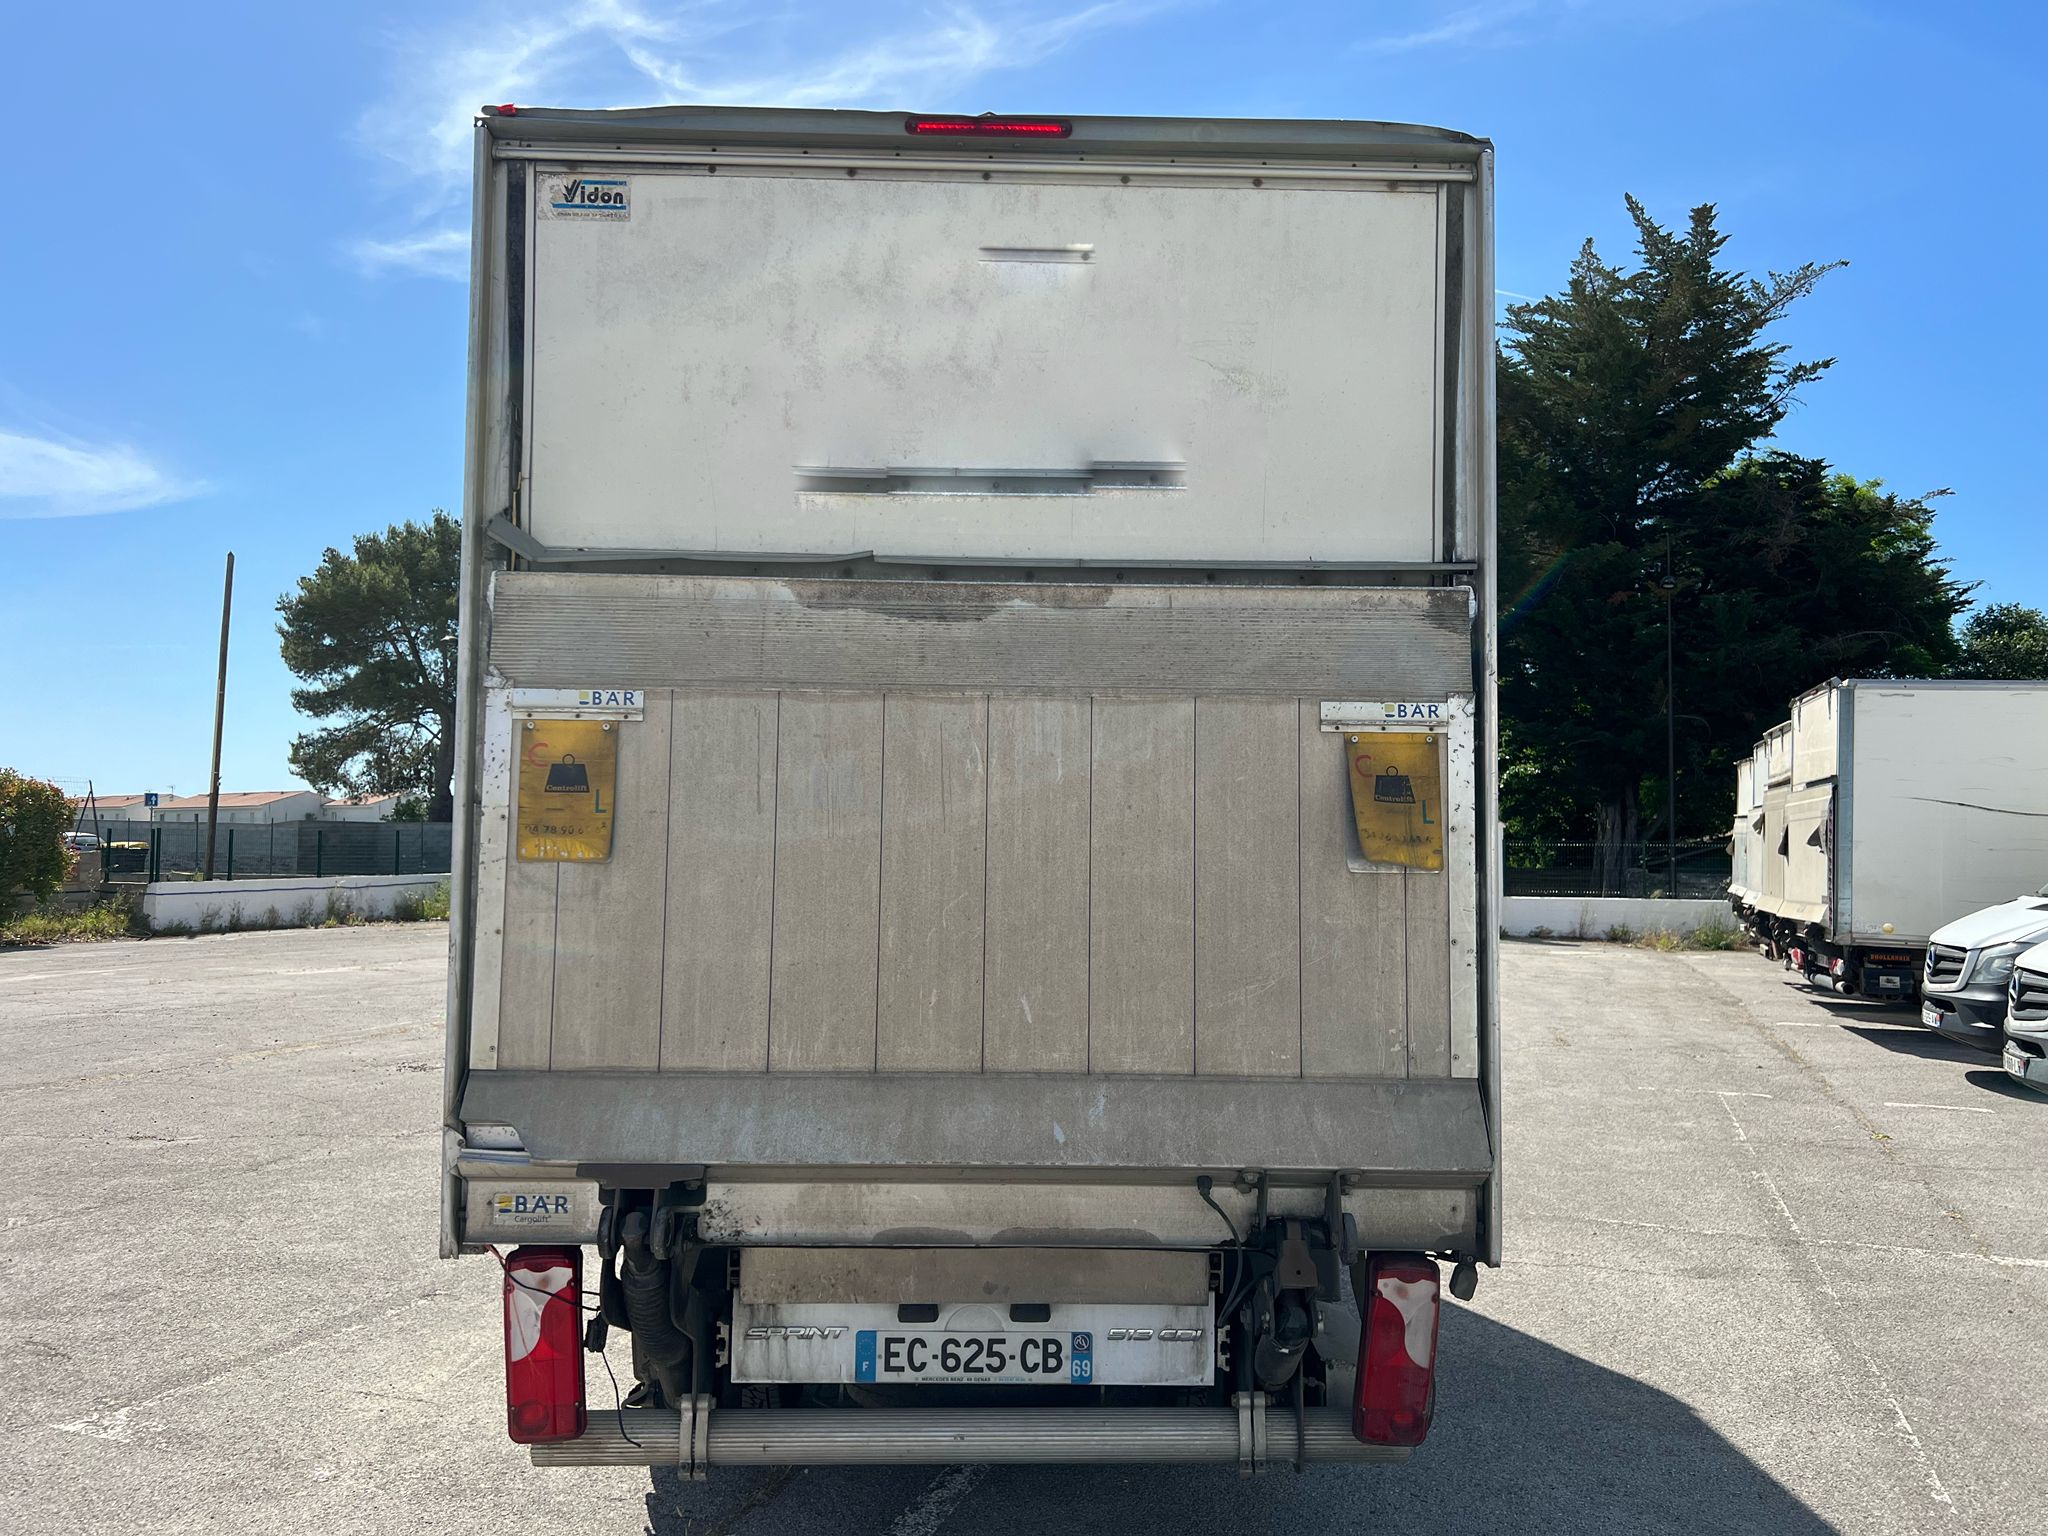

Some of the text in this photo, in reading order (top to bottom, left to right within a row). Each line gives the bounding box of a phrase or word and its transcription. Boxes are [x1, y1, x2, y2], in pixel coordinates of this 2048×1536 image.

[563, 179, 623, 204] Vidon
[528, 742, 548, 768] C
[594, 789, 607, 814] L
[1422, 800, 1434, 824] L
[515, 1195, 569, 1214] BÄR
[744, 1326, 849, 1341] SPRINT
[1158, 1329, 1203, 1341] CDI
[883, 1337, 1063, 1374] EC-625-CB
[862, 1361, 869, 1372] F
[1072, 1359, 1090, 1378] 69
